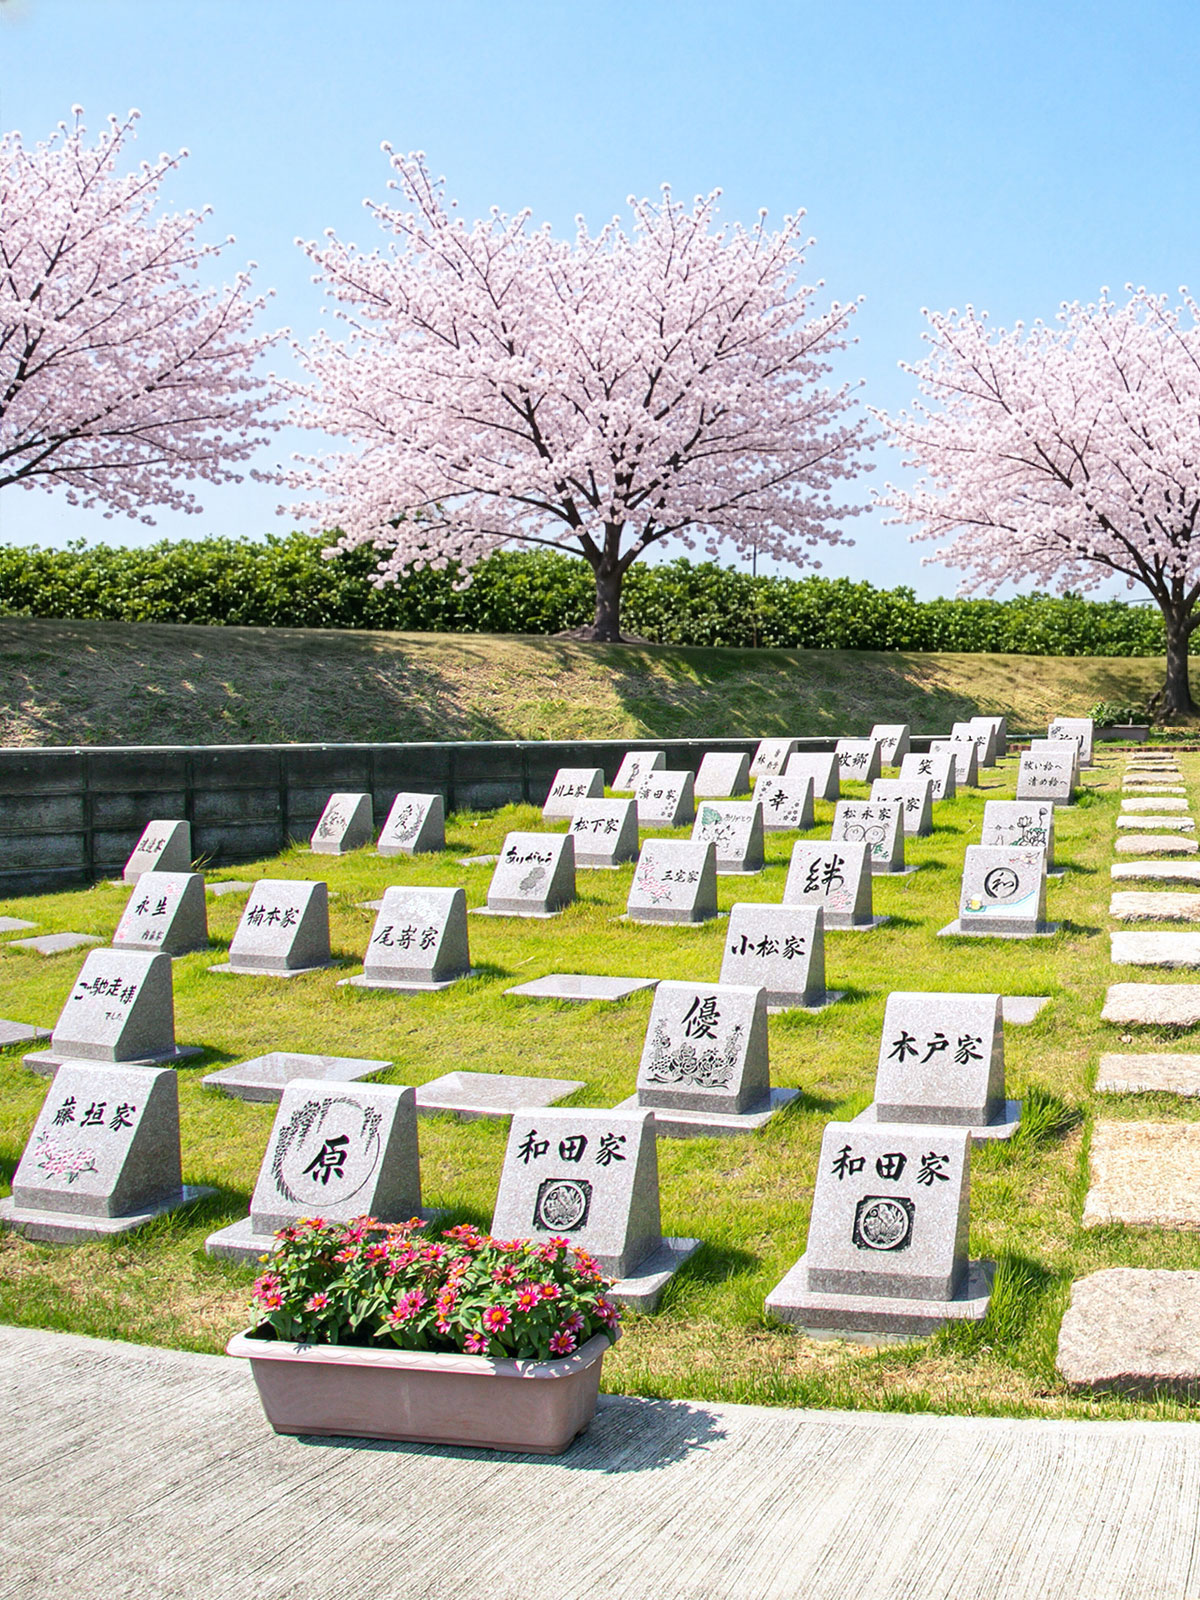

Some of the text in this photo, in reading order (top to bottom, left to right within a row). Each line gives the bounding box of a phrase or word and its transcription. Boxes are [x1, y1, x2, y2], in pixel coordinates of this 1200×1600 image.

[552, 784, 587, 798] 川上家
[769, 789, 788, 812] 幸
[573, 816, 619, 835] 松下家
[842, 807, 892, 821] 松永家
[660, 868, 700, 884] 三宅家
[803, 853, 845, 896] 絆
[134, 895, 168, 917] 永生
[247, 904, 300, 928] 楠本家
[731, 934, 806, 960] 小松家
[74, 976, 138, 1005] ご馳走様
[681, 995, 721, 1040] 優
[887, 1030, 984, 1065] 木戸家
[52, 1096, 136, 1132] 藤垣家
[302, 1134, 350, 1186] 原
[517, 1128, 627, 1167] 和田家
[831, 1144, 950, 1187] 和田家
